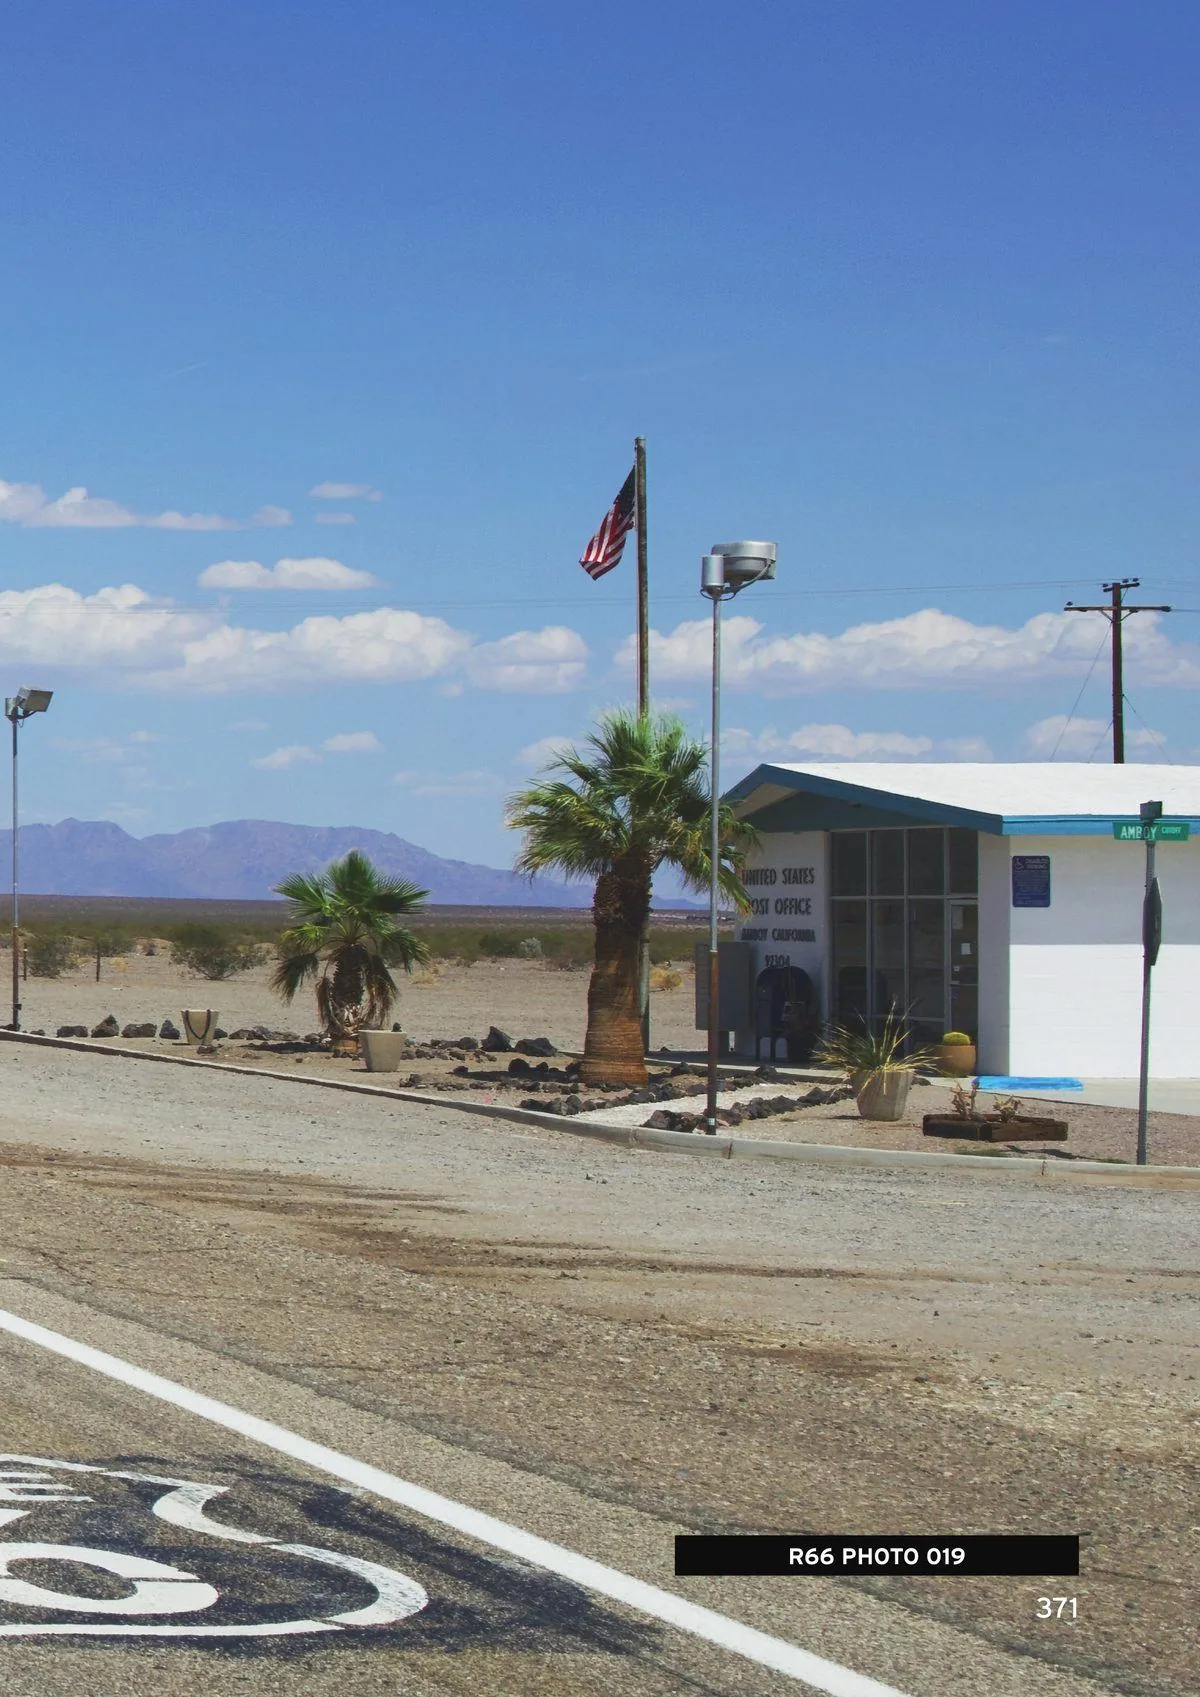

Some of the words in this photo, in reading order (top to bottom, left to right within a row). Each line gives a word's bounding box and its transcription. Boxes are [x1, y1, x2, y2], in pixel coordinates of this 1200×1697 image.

[1120, 825, 1157, 839] AMBOY
[742, 869, 777, 886] UNITED
[782, 867, 815, 885] STATES
[750, 897, 770, 915] OST
[775, 897, 812, 915] OFFICE
